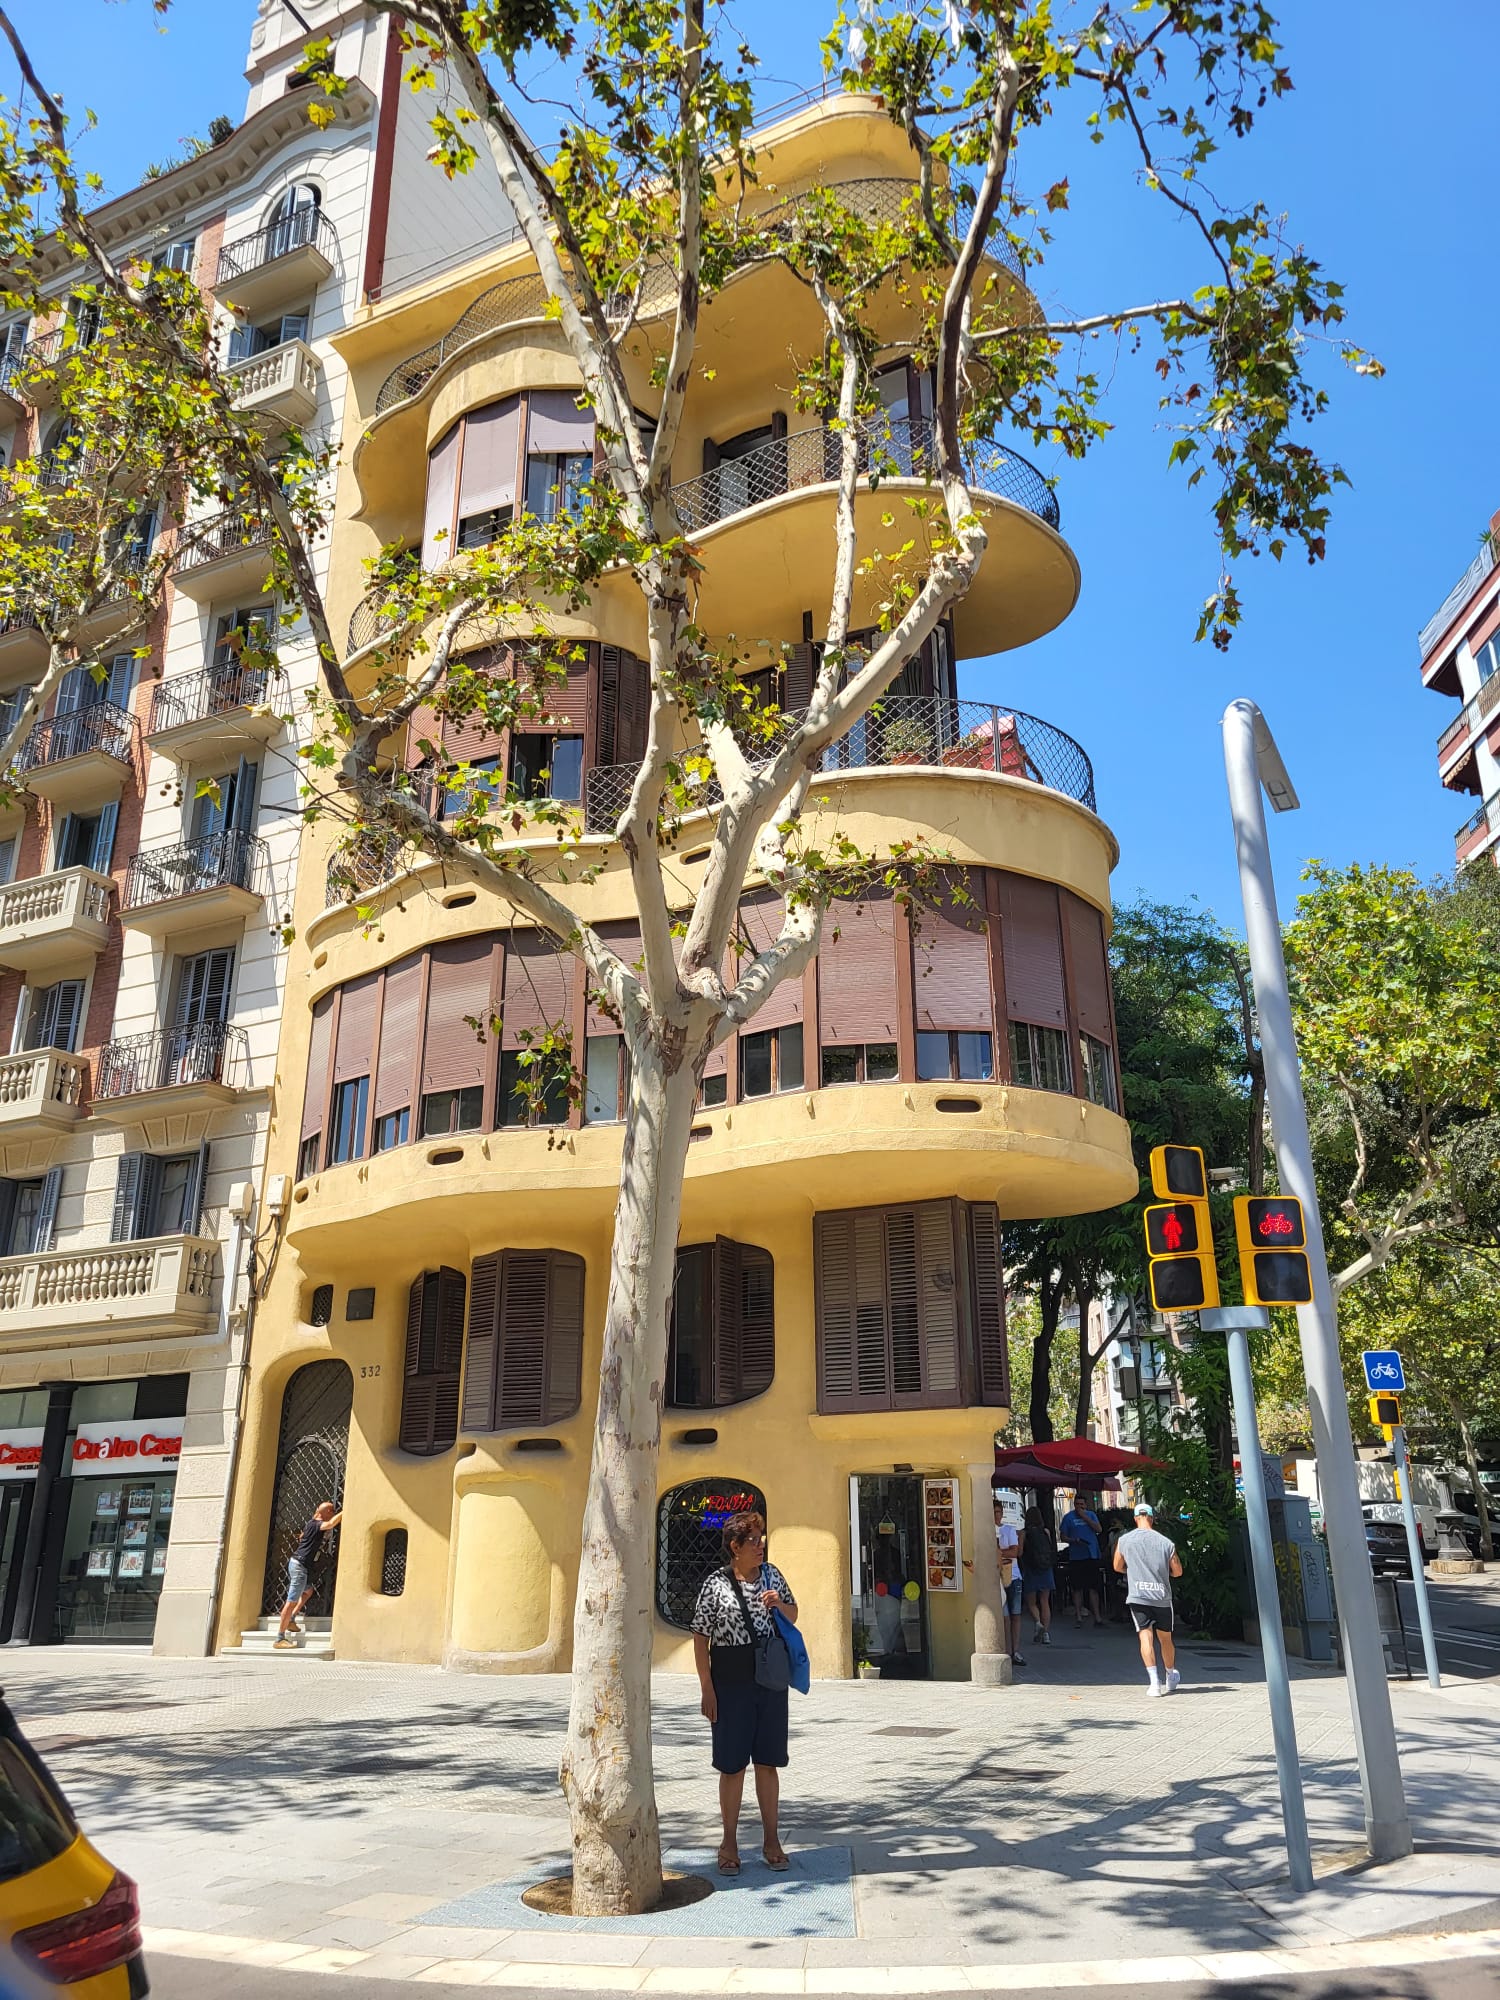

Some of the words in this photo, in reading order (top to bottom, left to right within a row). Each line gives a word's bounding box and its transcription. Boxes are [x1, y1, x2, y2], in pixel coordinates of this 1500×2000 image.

[361, 1365, 381, 1378] 332
[139, 1434, 182, 1456] Casa
[707, 1494, 754, 1511] FONDA
[1135, 1581, 1165, 1591] YEEZUS
